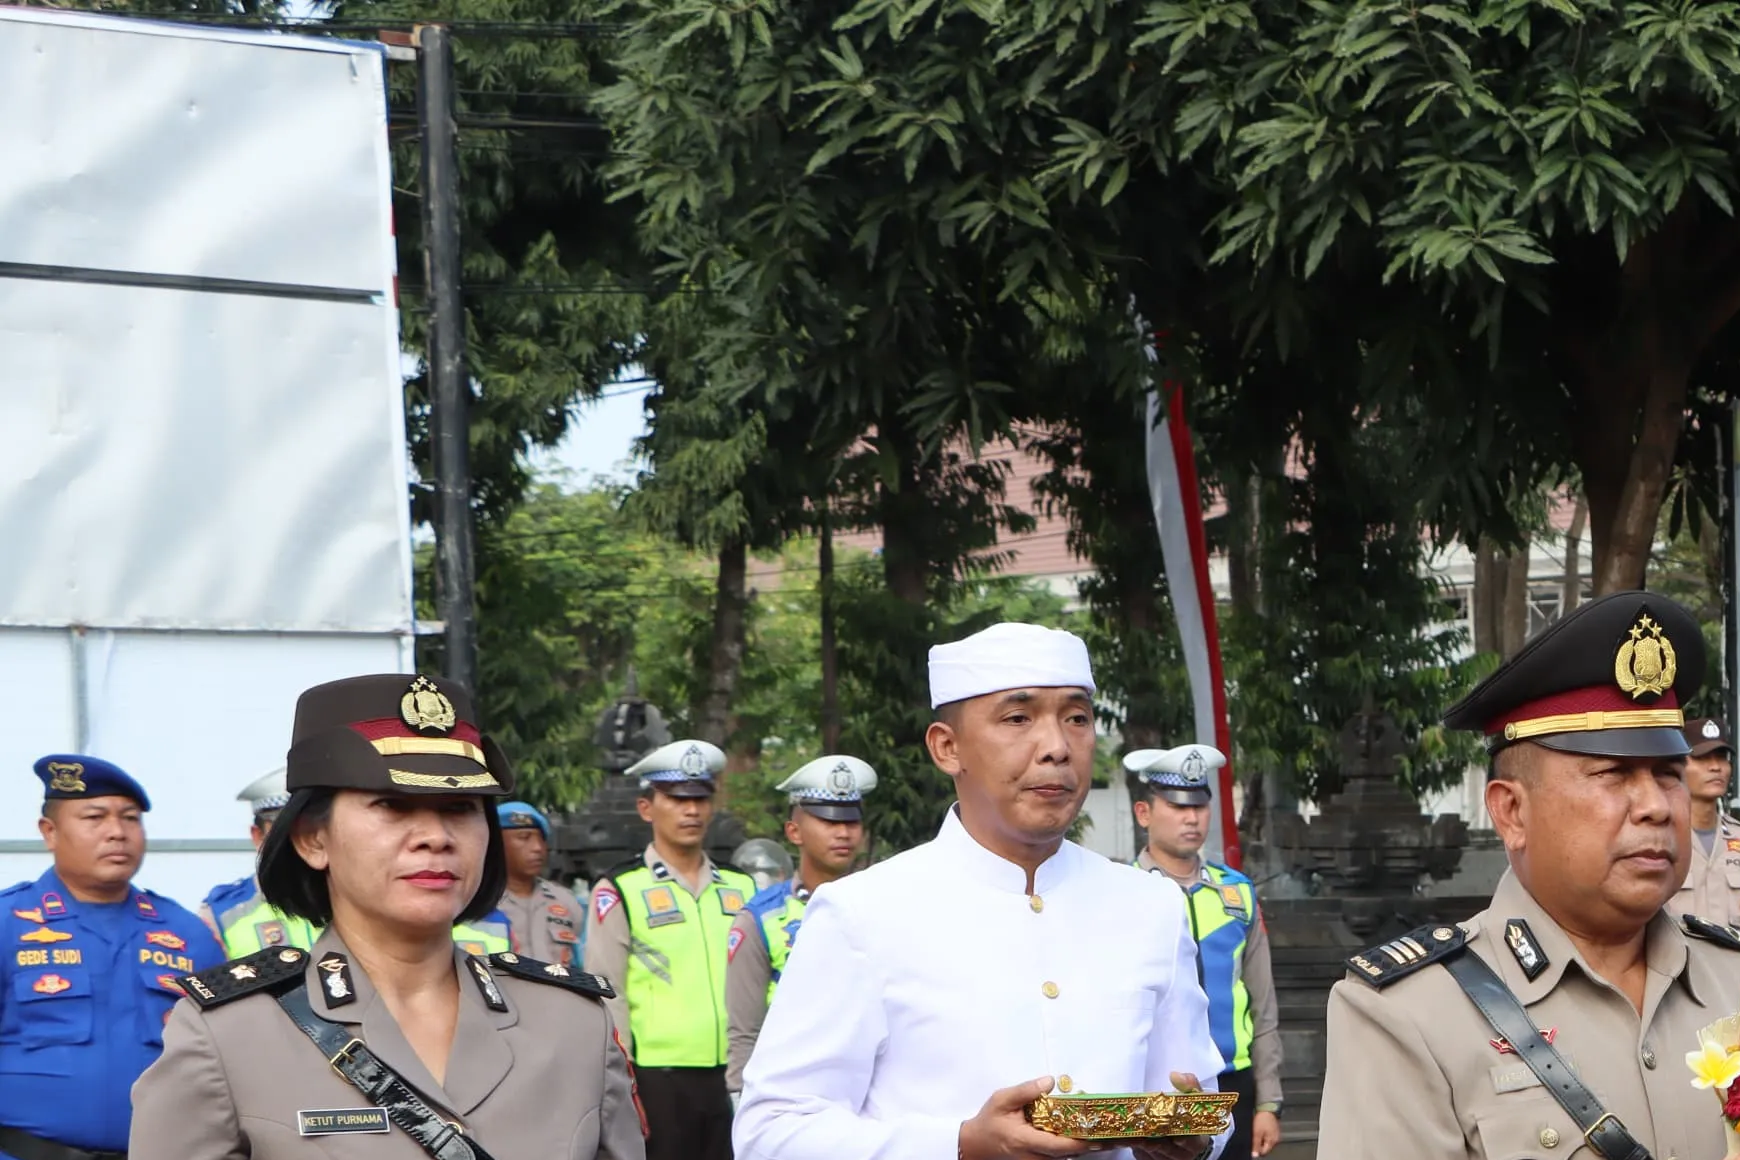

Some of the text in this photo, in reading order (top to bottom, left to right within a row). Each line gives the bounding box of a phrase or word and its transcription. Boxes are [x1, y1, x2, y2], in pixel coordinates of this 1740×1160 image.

[17, 949, 82, 966] GEDE SUDI
[140, 949, 193, 972] POLRI
[1350, 956, 1383, 977] POLISI
[186, 976, 215, 1000] POLISI
[304, 1113, 383, 1127] KETUT PURNAMA
